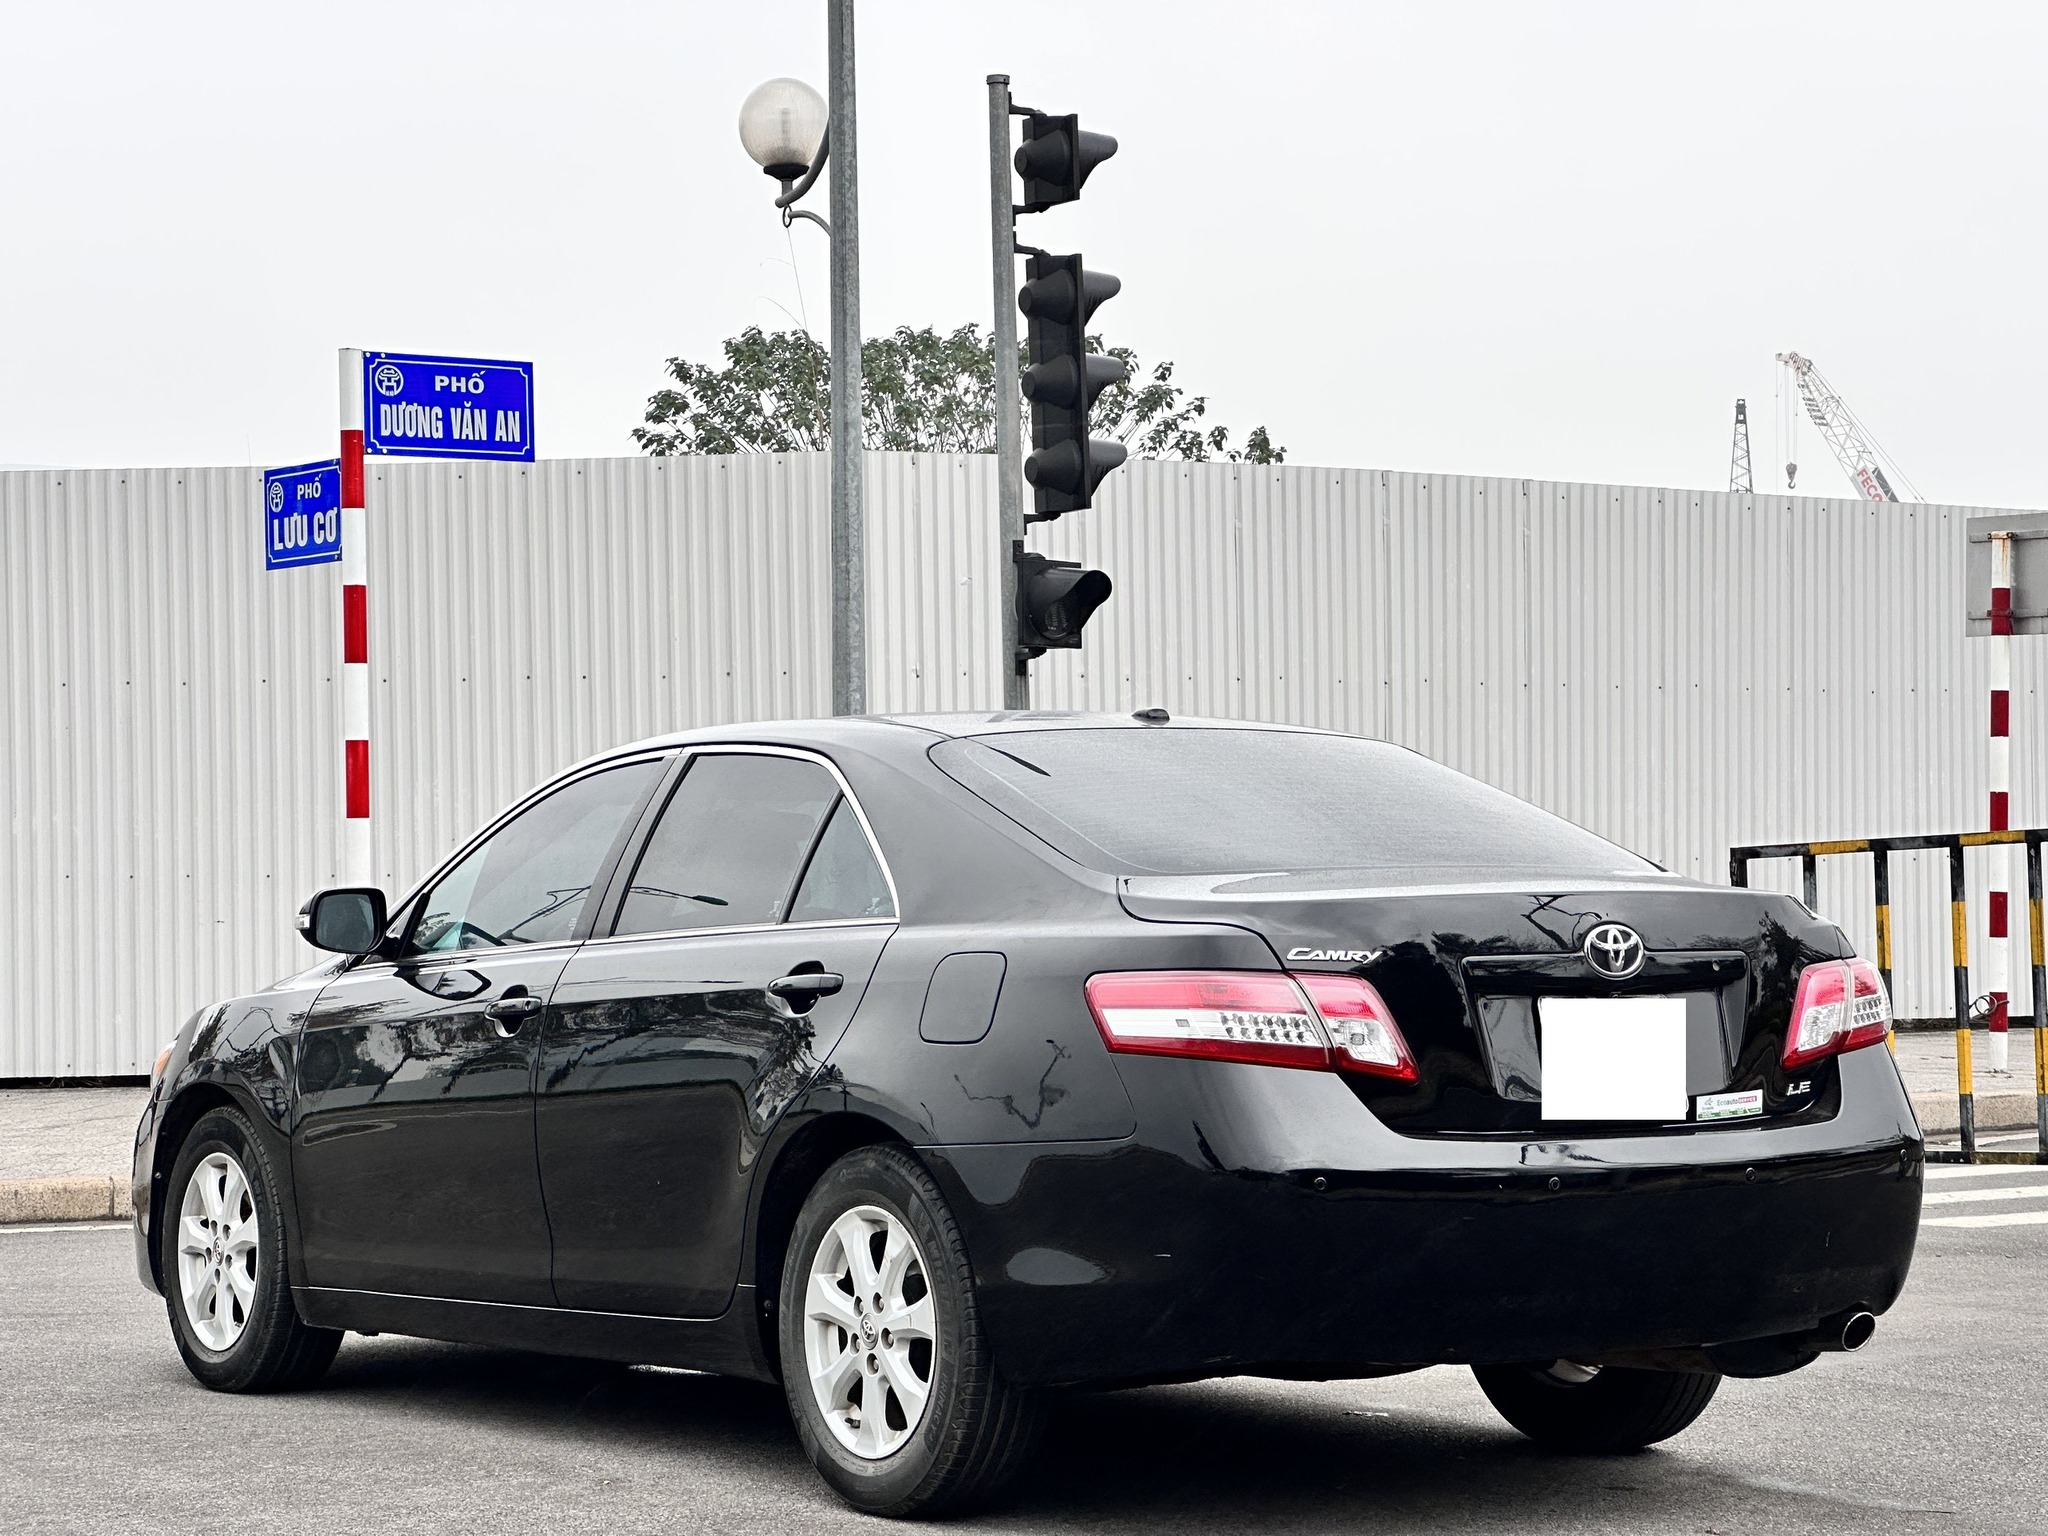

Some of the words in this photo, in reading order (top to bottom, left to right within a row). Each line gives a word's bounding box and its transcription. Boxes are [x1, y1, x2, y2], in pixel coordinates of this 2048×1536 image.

[434, 371, 486, 394] PHỐ
[380, 401, 443, 439] DƯƠNG
[450, 401, 487, 441] VĂN
[494, 410, 521, 443] AN
[297, 474, 322, 500] PHỐ
[273, 512, 308, 551] LƯU
[314, 507, 338, 545] CƠ
[1286, 947, 1383, 965] CAMRY
[1786, 1081, 1811, 1096] LE
